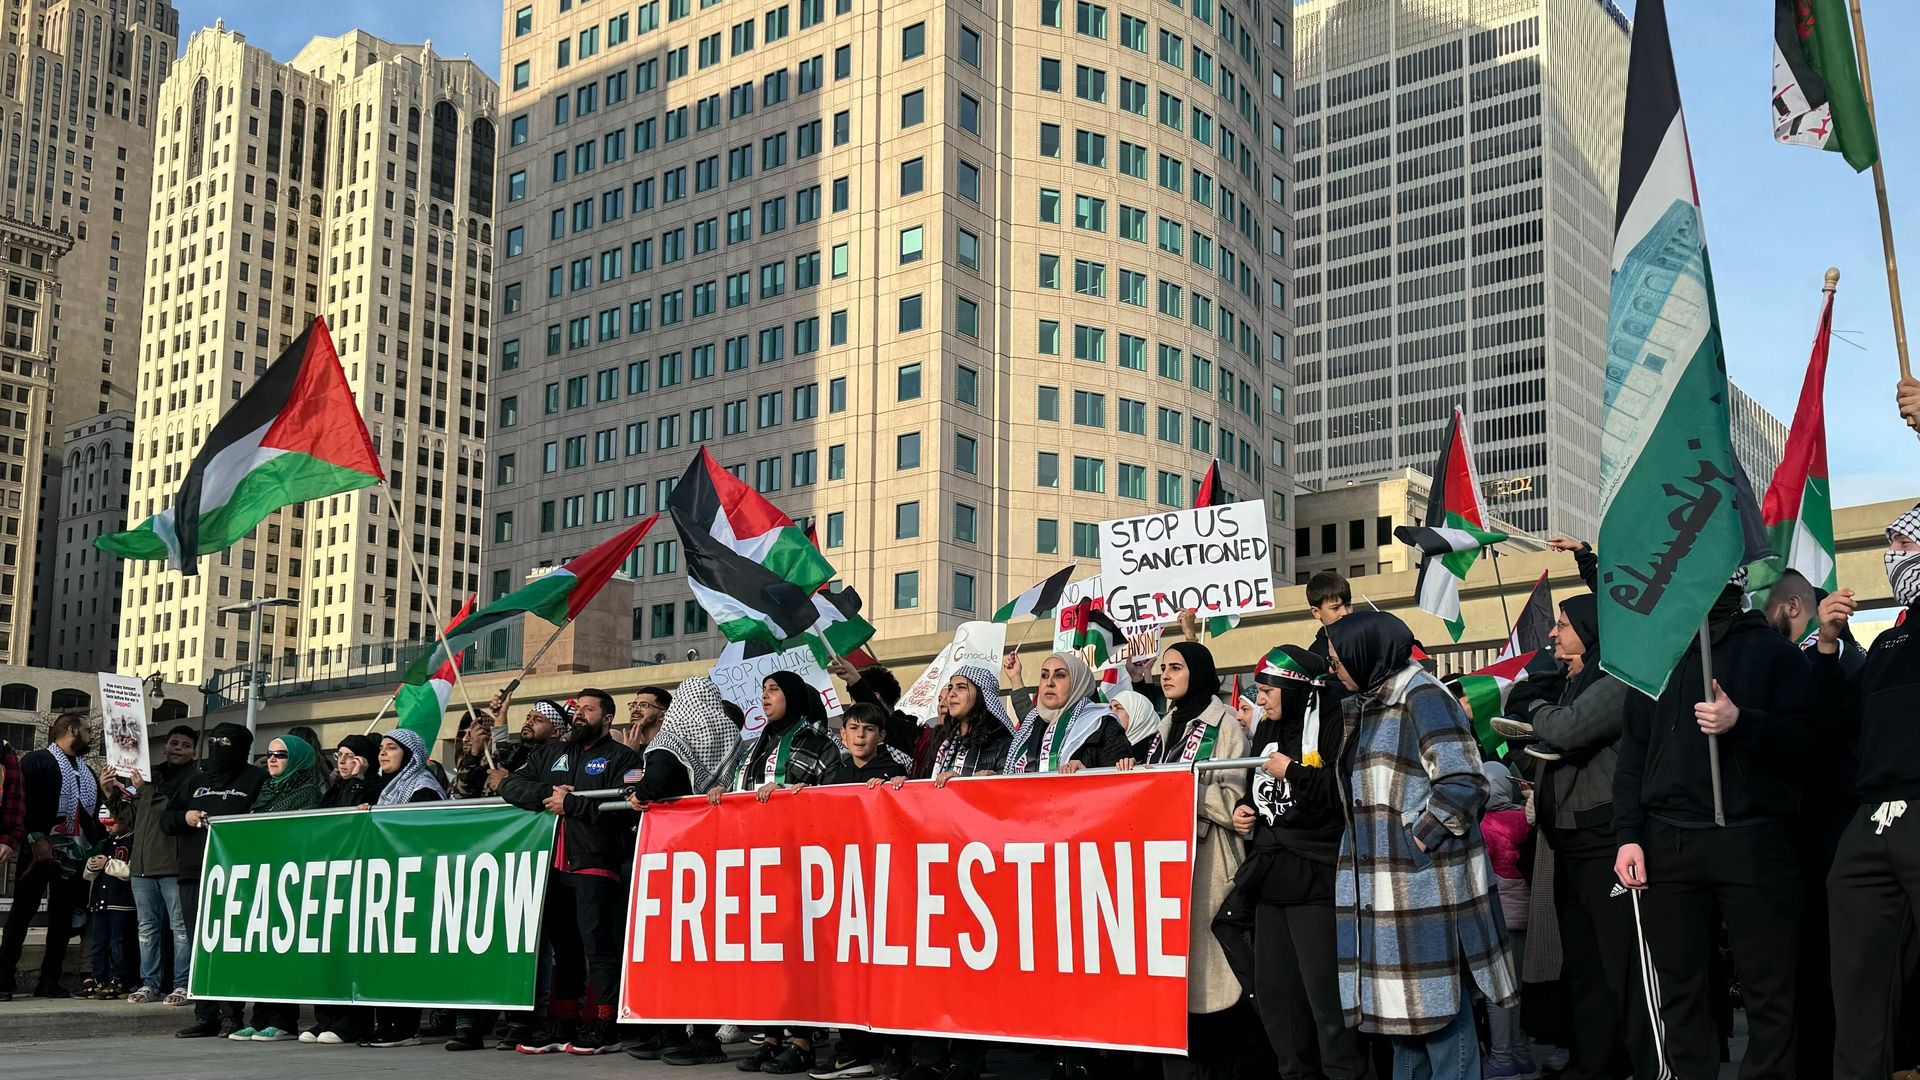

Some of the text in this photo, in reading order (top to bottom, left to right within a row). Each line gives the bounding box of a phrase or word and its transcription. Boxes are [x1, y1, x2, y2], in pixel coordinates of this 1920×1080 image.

[1111, 507, 1239, 548] STOP US
[1120, 537, 1267, 575] SANCTIONED
[1106, 578, 1273, 622] GENOCIDE
[714, 662, 752, 685] STOP
[954, 646, 998, 663] Genocide
[201, 850, 549, 955] CEASEFIRE NOW
[632, 840, 1188, 978] FREE PALESTINE
